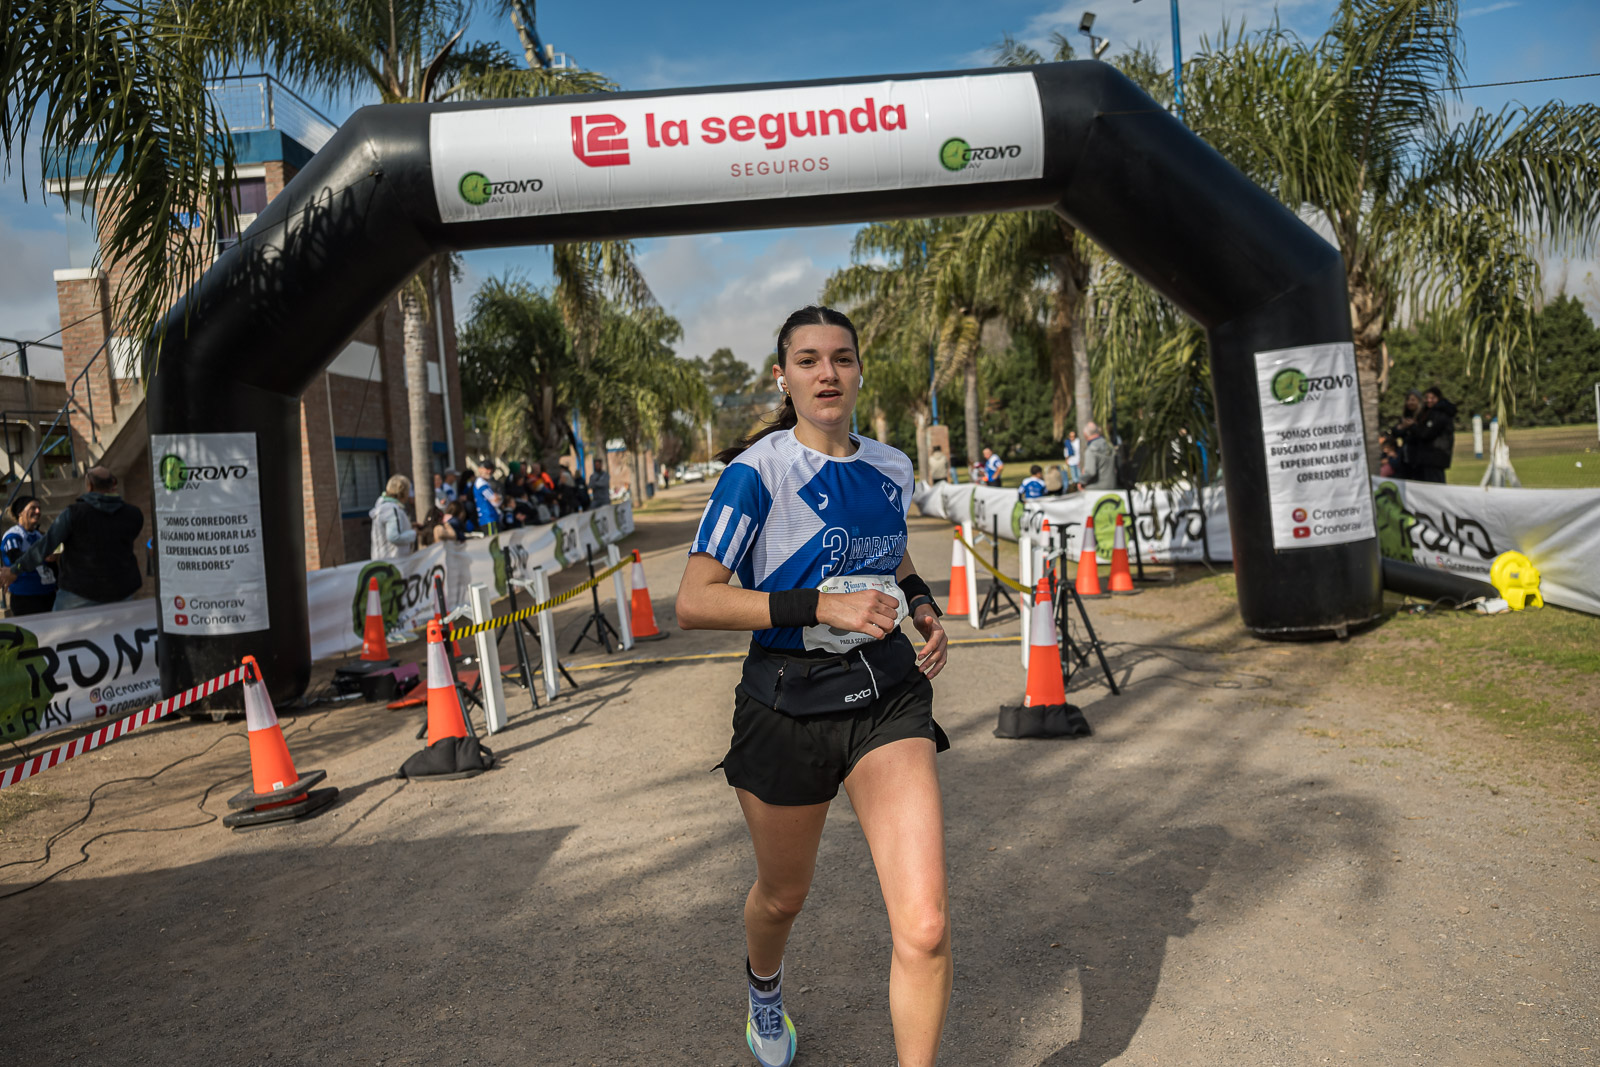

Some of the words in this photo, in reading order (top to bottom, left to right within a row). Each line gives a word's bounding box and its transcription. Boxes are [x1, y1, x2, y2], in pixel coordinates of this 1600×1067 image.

[645, 113, 689, 148] la
[701, 97, 907, 150] segunda
[730, 157, 830, 178] SEGUROS
[1271, 443, 1317, 457] BUSCANDO
[1280, 454, 1339, 470] EXPERIENCIAS
[1340, 453, 1349, 463] DE
[190, 514, 248, 527] CORREDORES
[1312, 507, 1360, 521] Cronorav
[197, 529, 239, 541] MEJORAR
[240, 528, 257, 539] LAS
[166, 545, 218, 557] EXPERIENCIAS
[219, 544, 232, 555] DE
[233, 543, 250, 554] LOS
[190, 598, 245, 610] Cronorav
[190, 614, 246, 626] Cronorav
[845, 688, 872, 703] EXO
[22, 697, 72, 735] RAV
